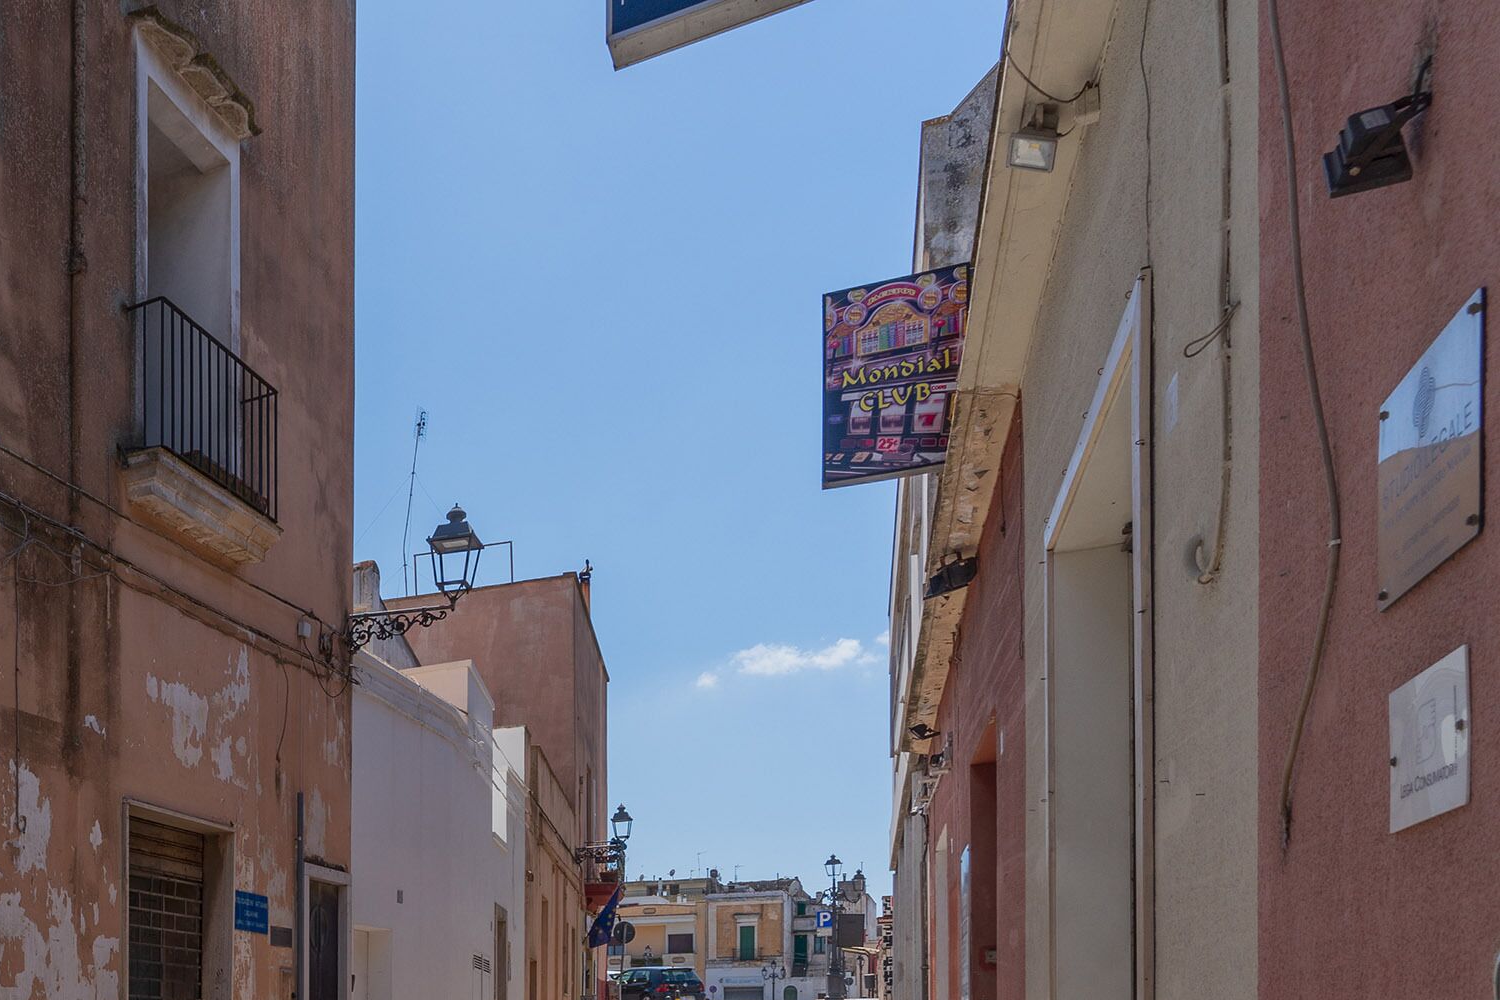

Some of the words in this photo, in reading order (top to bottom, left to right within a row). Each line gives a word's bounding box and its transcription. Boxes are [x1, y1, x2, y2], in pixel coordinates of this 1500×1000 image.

[842, 348, 951, 388] Mondial
[859, 383, 931, 412] CLUB
[1423, 401, 1474, 468] LEGALE
[819, 912, 831, 927] P
